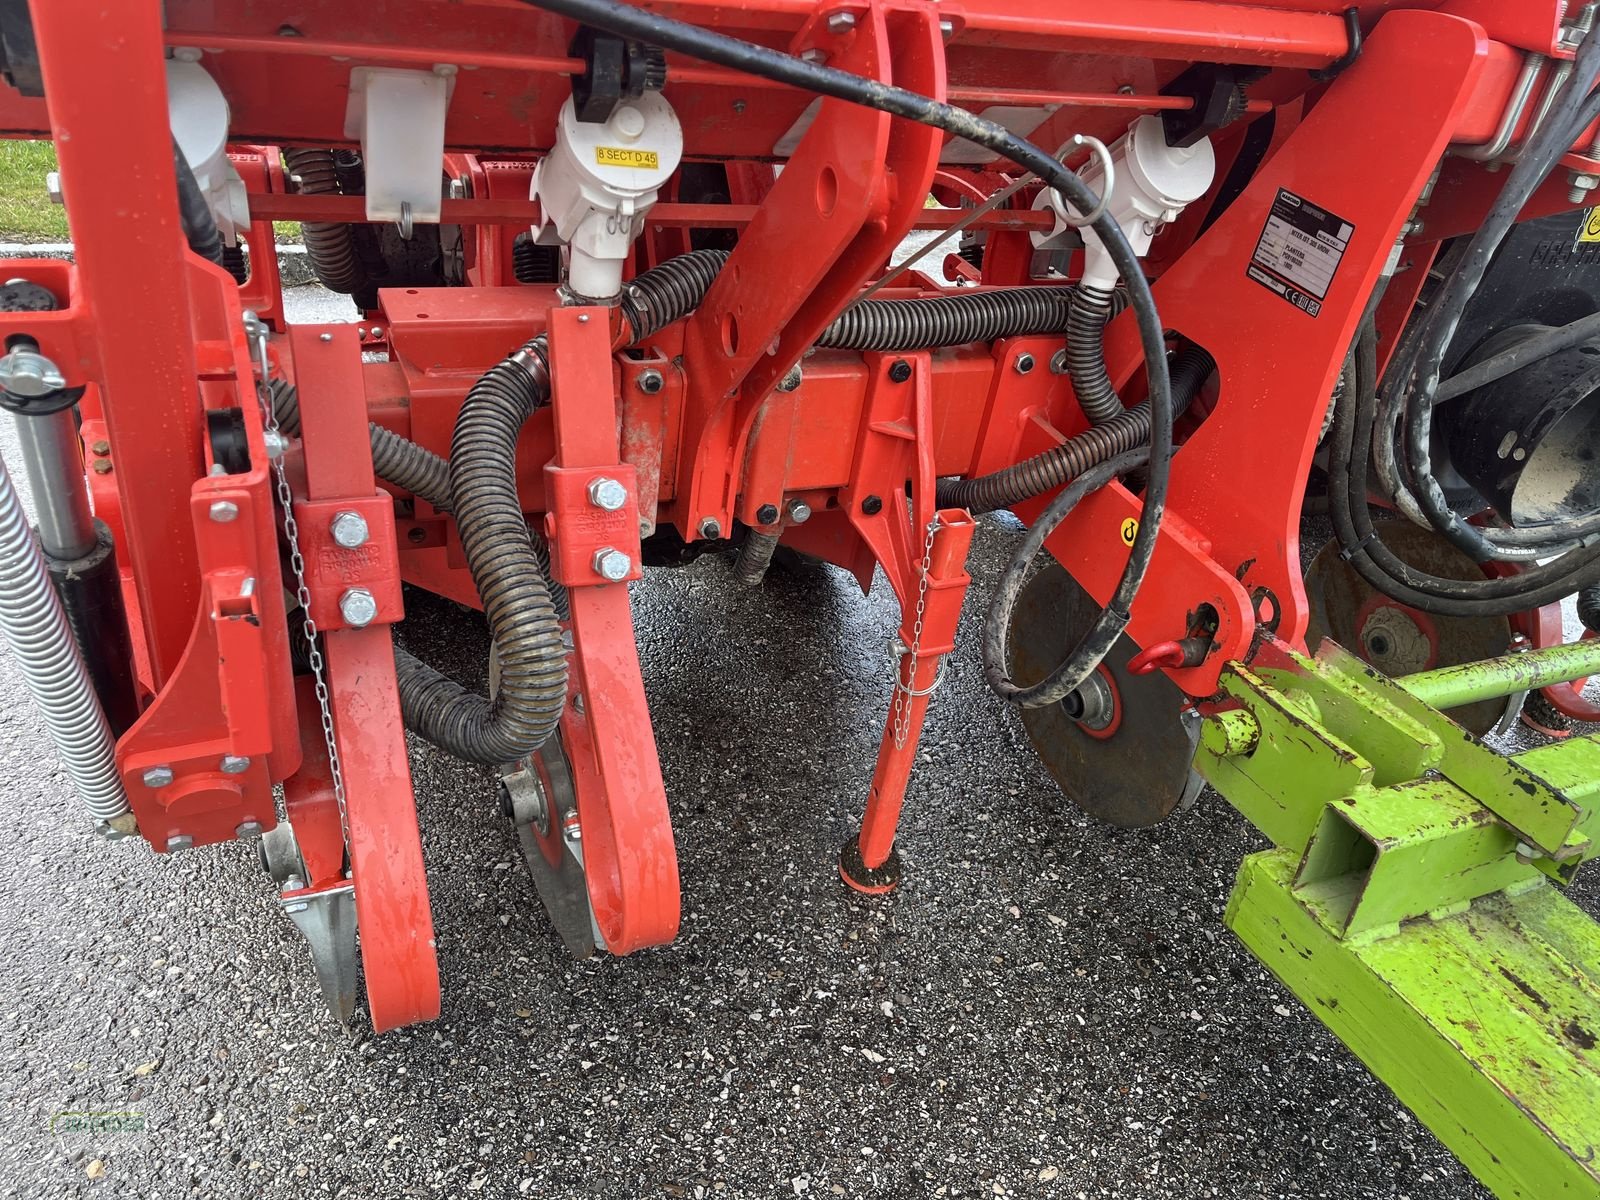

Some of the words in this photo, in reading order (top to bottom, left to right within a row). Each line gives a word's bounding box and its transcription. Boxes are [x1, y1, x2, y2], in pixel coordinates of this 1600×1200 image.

[598, 148, 605, 159] 8
[606, 149, 633, 161] SECT
[635, 152, 643, 162] D
[644, 153, 656, 164] 45
